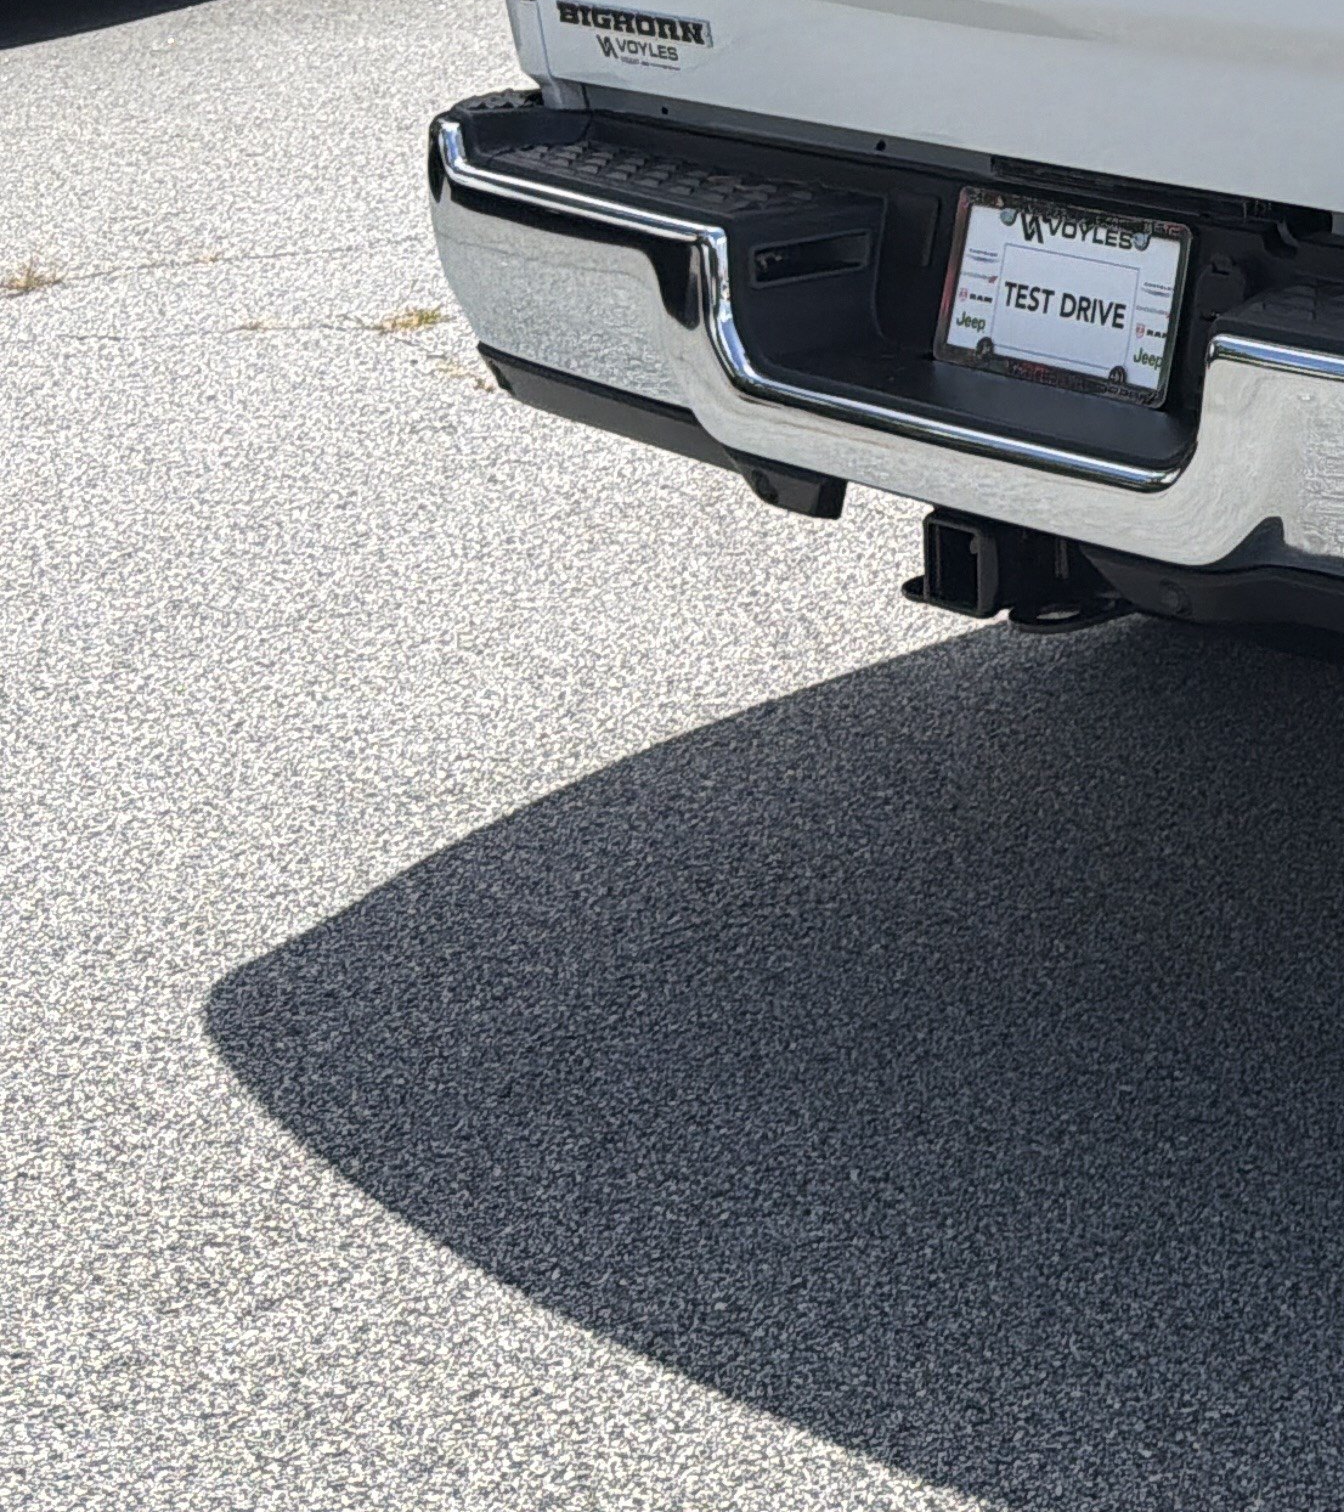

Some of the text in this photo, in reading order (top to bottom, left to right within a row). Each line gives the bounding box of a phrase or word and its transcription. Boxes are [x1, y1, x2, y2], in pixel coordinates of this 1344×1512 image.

[615, 37, 679, 61] VOYLES
[1049, 216, 1133, 250] VOYLES
[1004, 280, 1127, 330] TEST DRIVE
[955, 310, 987, 333] Jeep
